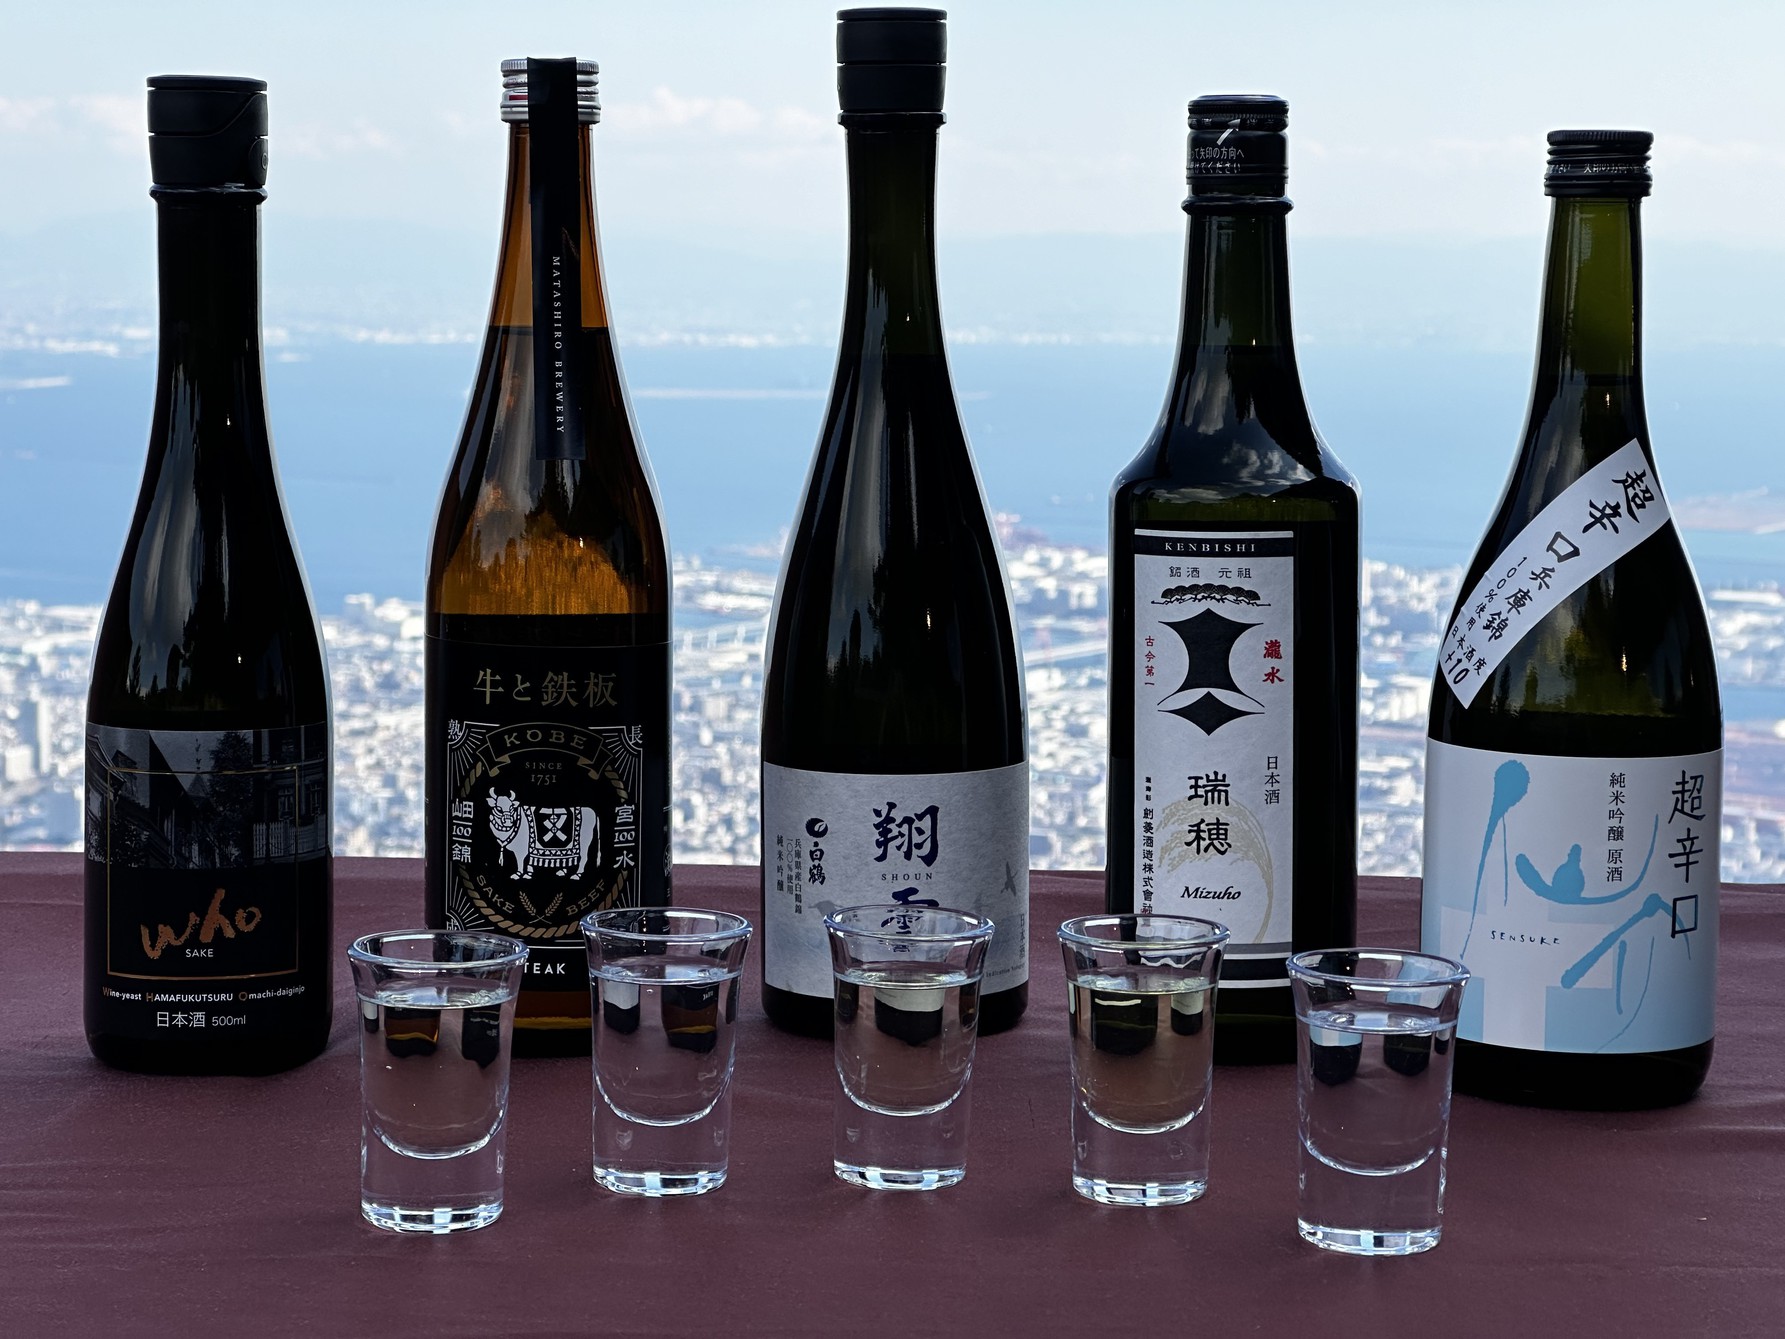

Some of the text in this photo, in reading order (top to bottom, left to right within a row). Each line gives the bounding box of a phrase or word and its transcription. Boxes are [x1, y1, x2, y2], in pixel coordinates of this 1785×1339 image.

[552, 256, 565, 433] MATASHIRO BREWERY
[1546, 469, 1655, 563] 超辛口
[1165, 542, 1256, 552] KENBISHI
[1483, 566, 1556, 642] 兵庫錦
[1452, 626, 1488, 676] 日本酒度
[1445, 653, 1470, 685] +10
[473, 668, 618, 708] 牛と鉄板
[504, 728, 588, 750] KOBE
[525, 761, 564, 771] SINCE
[530, 773, 558, 786] 1751
[1264, 755, 1281, 805] 日本酒
[1184, 770, 1232, 856] 瑞穂
[452, 824, 473, 838] 100
[614, 829, 636, 842] 100
[808, 840, 827, 886] 白鶴
[1667, 770, 1706, 939] 超辛口
[881, 873, 933, 881] SHOUN
[476, 874, 605, 916] SAKE BEEF
[1180, 885, 1242, 901] Mizuho
[1491, 930, 1561, 946] SENSUKE
[185, 948, 215, 958] SAKE
[523, 962, 567, 976] TEAK
[102, 985, 306, 1003] Wine-yeast HAMAFUKUTSURU Omachi-daiginjo
[156, 1011, 247, 1029] 日本酒 500ml
